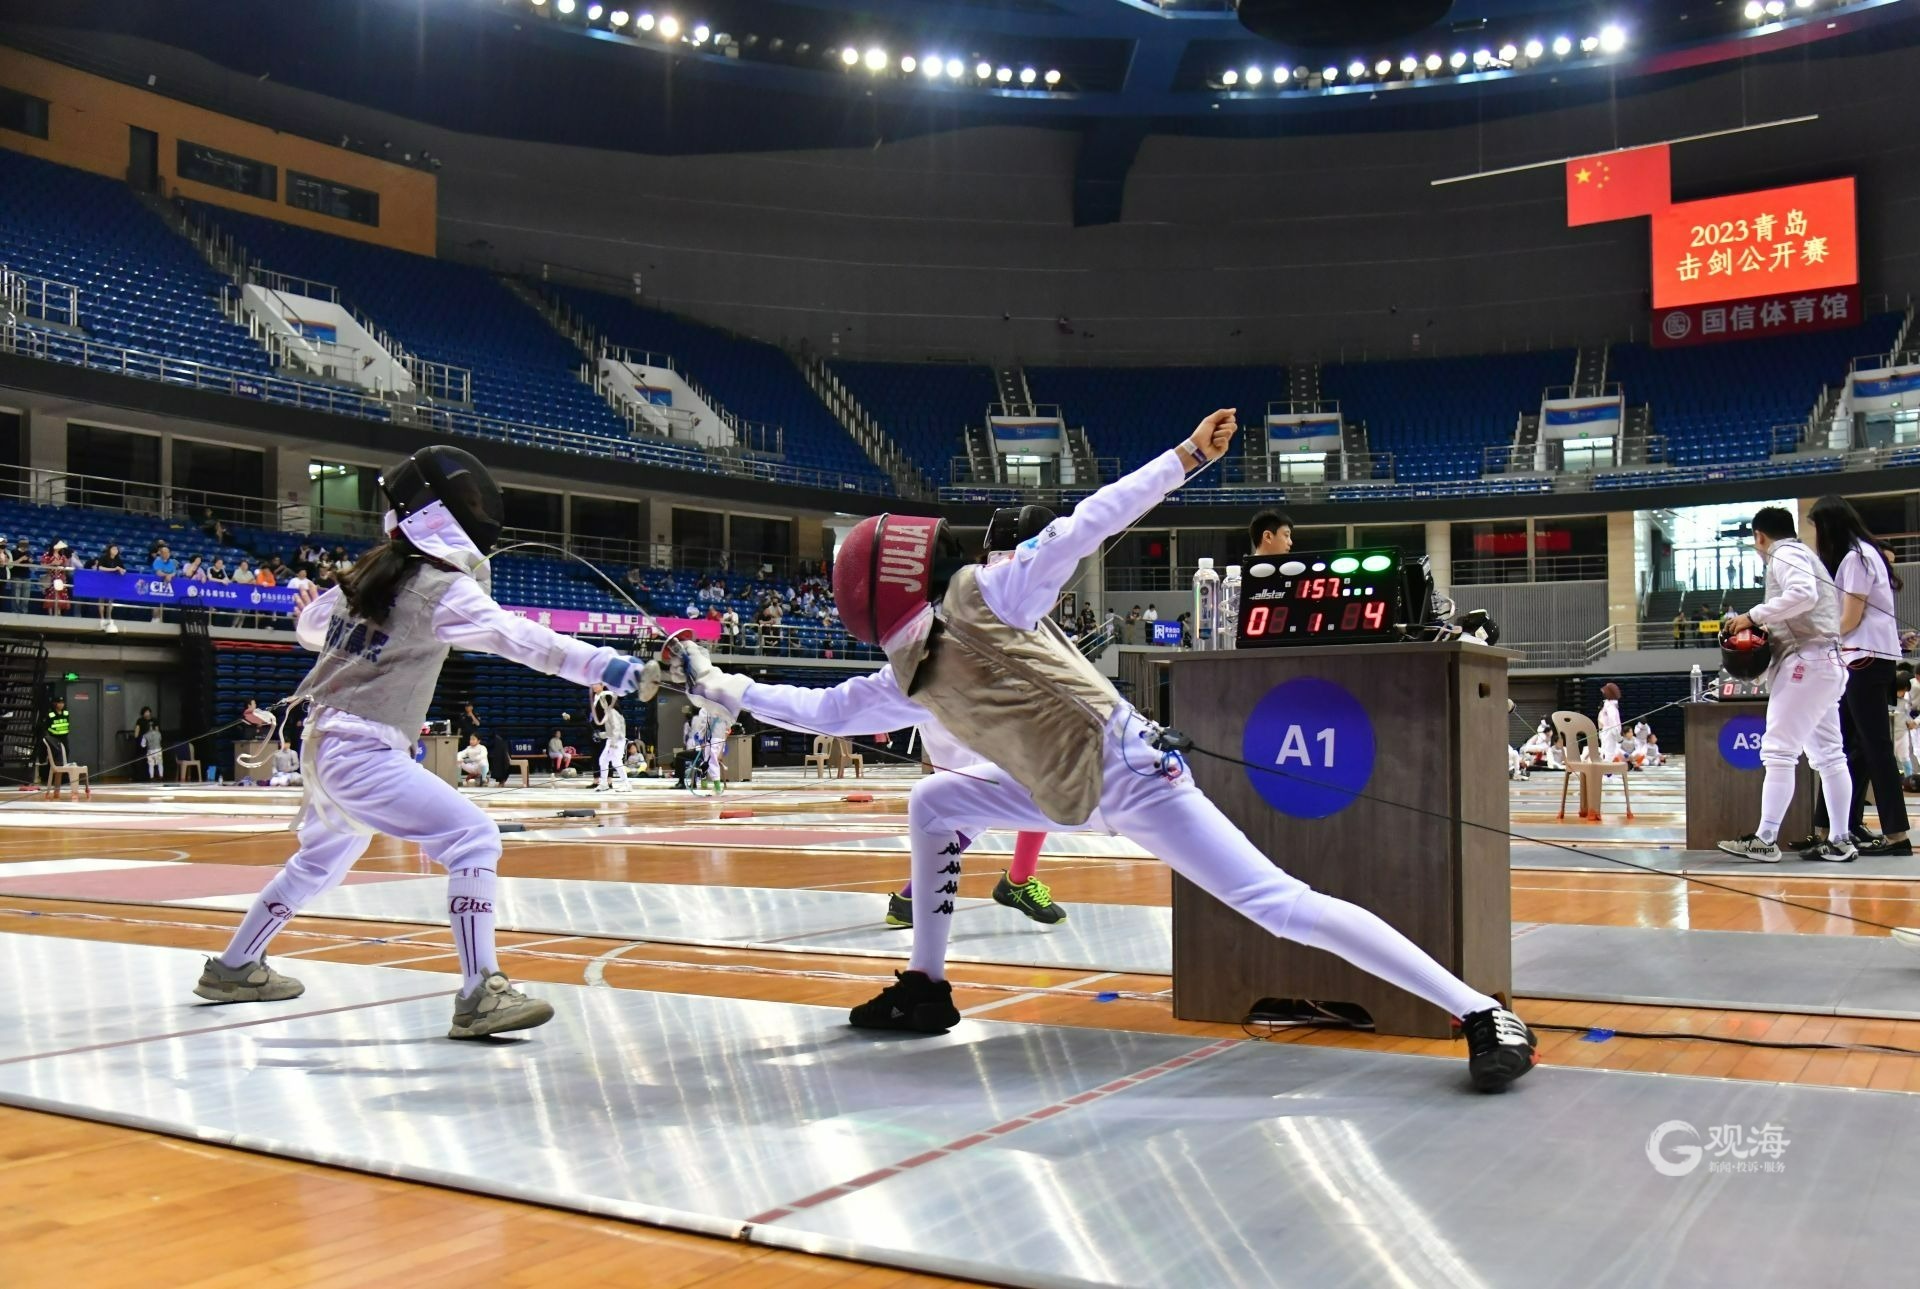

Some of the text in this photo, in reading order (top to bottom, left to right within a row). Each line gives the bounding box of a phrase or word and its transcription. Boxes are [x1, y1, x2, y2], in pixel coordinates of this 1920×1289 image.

[1691, 208, 1808, 248] 2023青岛
[1676, 236, 1829, 281] 击剑公开赛
[1702, 293, 1849, 335] 国信体育馆
[879, 524, 931, 593] JULIA
[1250, 588, 1286, 600] allstar
[1364, 601, 1386, 629] 4
[1275, 724, 1336, 768] A1
[1733, 732, 1762, 750] A3
[1745, 845, 1775, 855] Kempa
